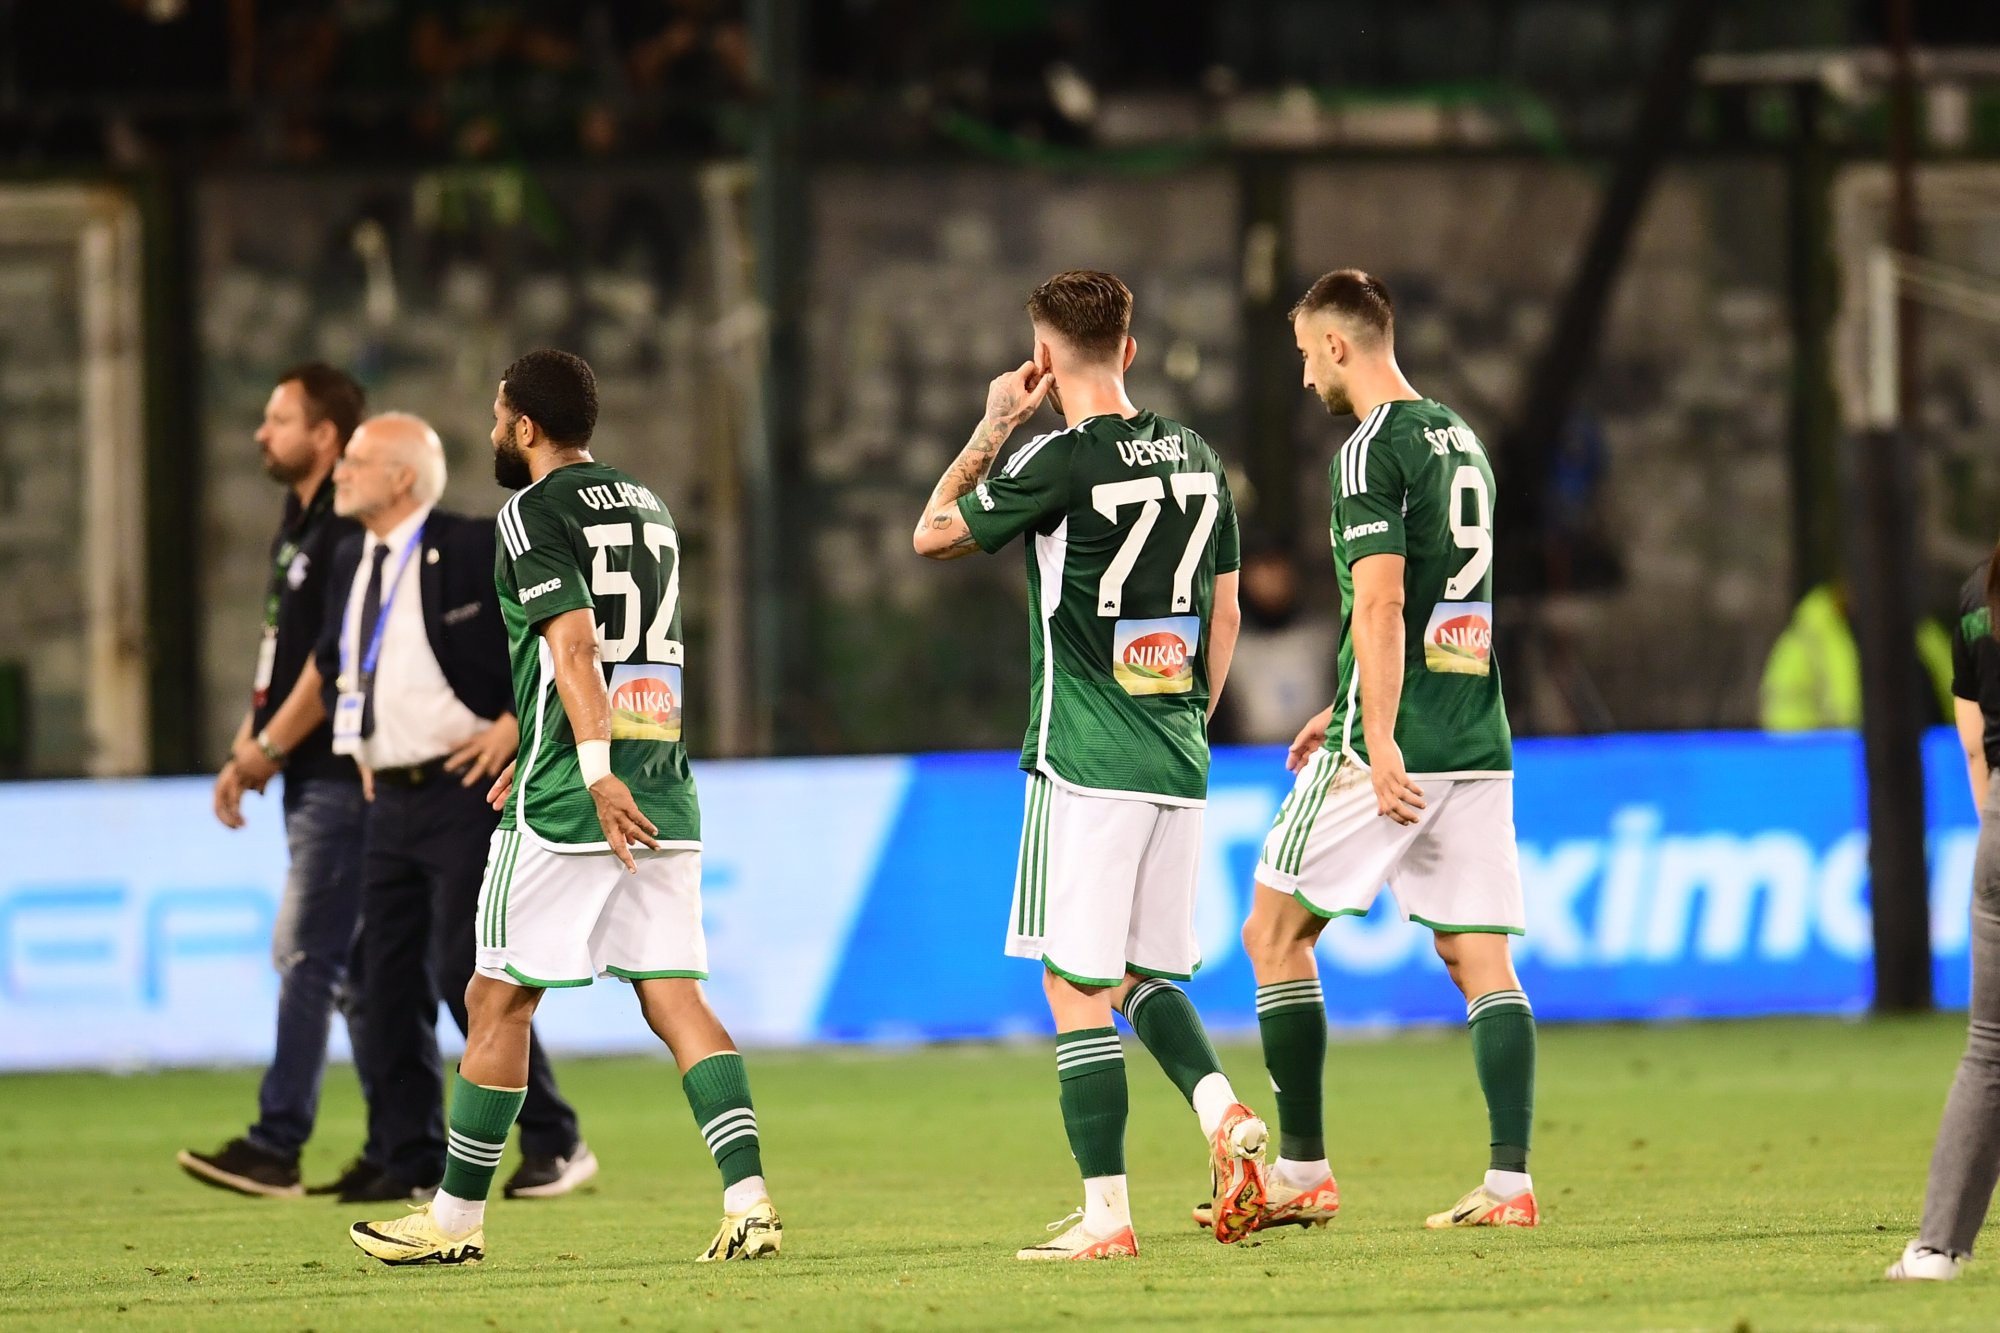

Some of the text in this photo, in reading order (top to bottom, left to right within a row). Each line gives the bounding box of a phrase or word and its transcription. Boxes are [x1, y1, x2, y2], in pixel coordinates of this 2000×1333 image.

[1092, 472, 1219, 617] 77
[1444, 465, 1493, 600] 9
[583, 522, 684, 667] 52
[1129, 643, 1184, 667] NIKAS
[1440, 627, 1490, 649] NIKAS
[617, 691, 671, 713] NIKAS
